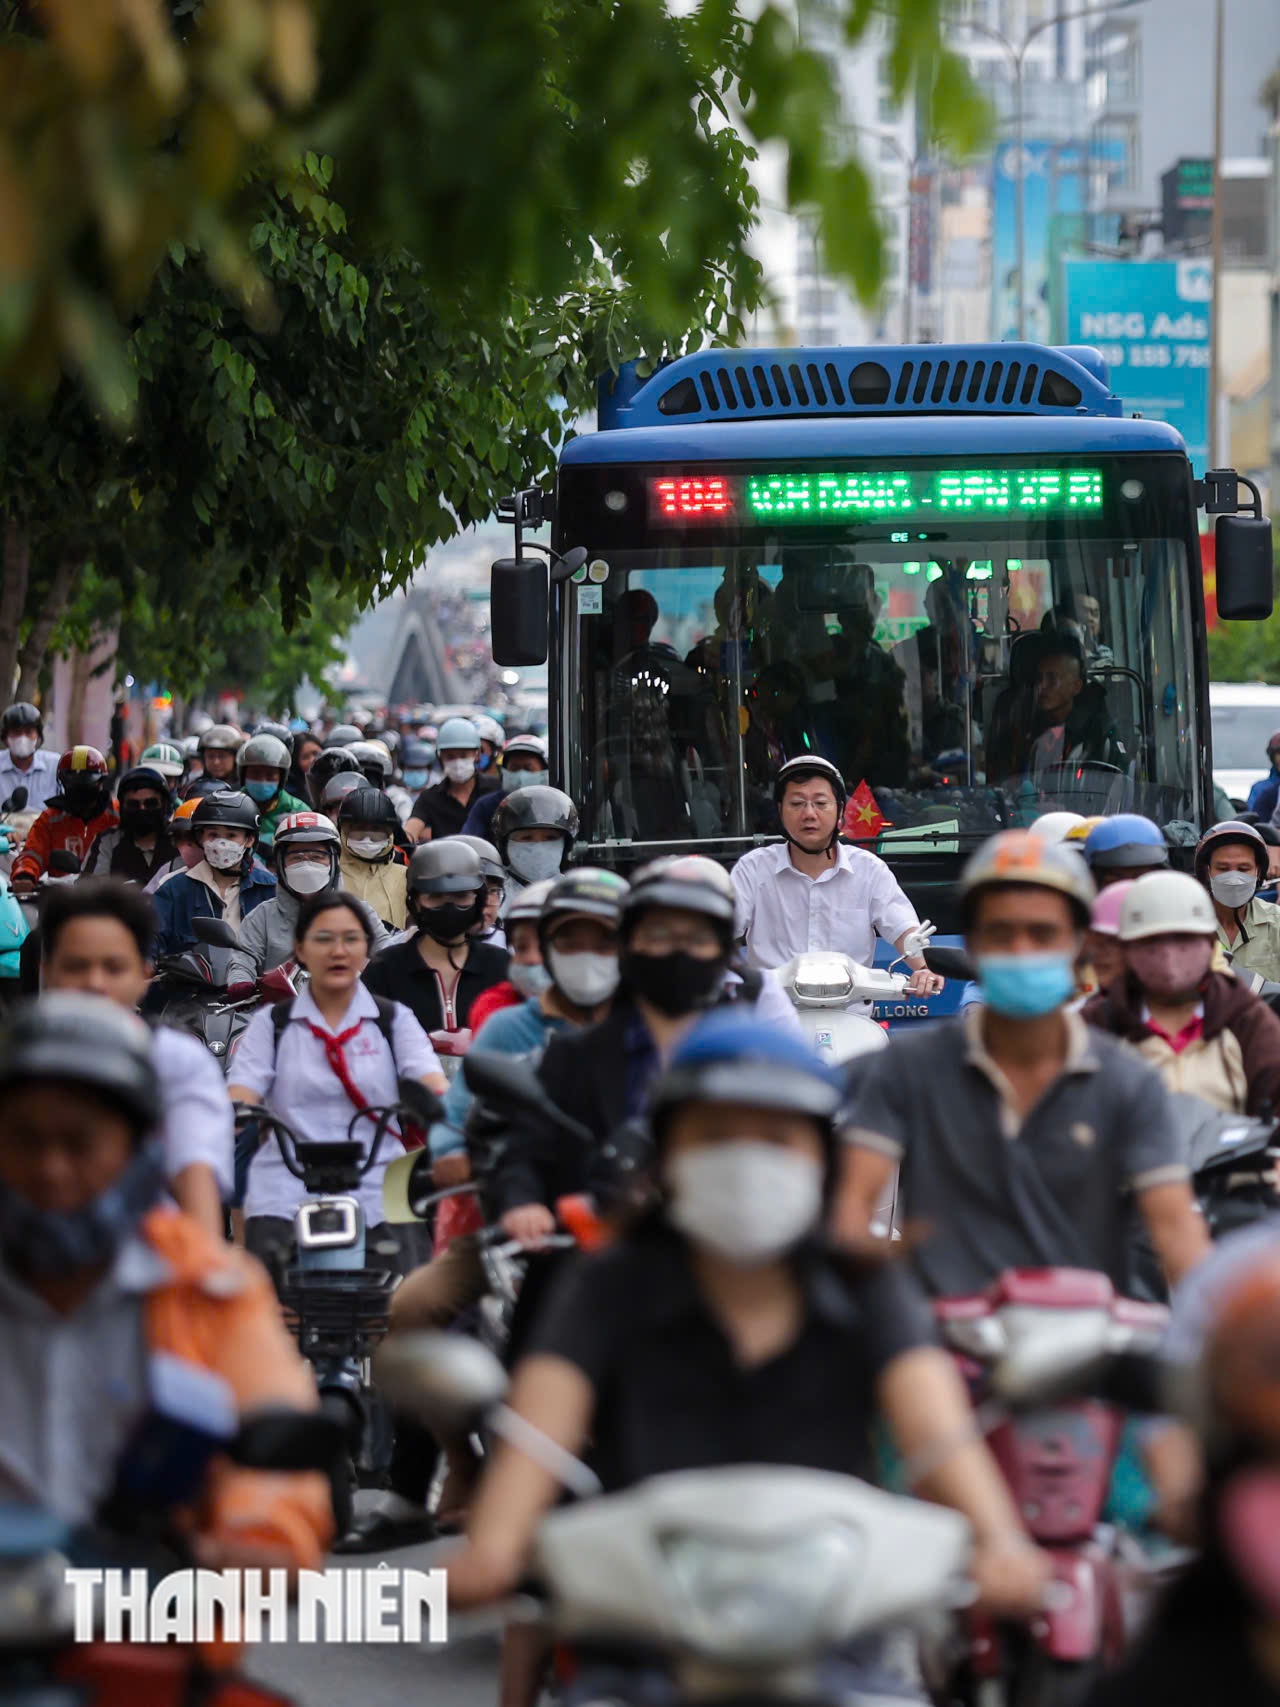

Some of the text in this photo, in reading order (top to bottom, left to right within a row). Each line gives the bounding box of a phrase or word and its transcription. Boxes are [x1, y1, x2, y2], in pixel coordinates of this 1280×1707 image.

[1080, 311, 1208, 339] NSG Ads
[885, 1005, 929, 1018] LONG
